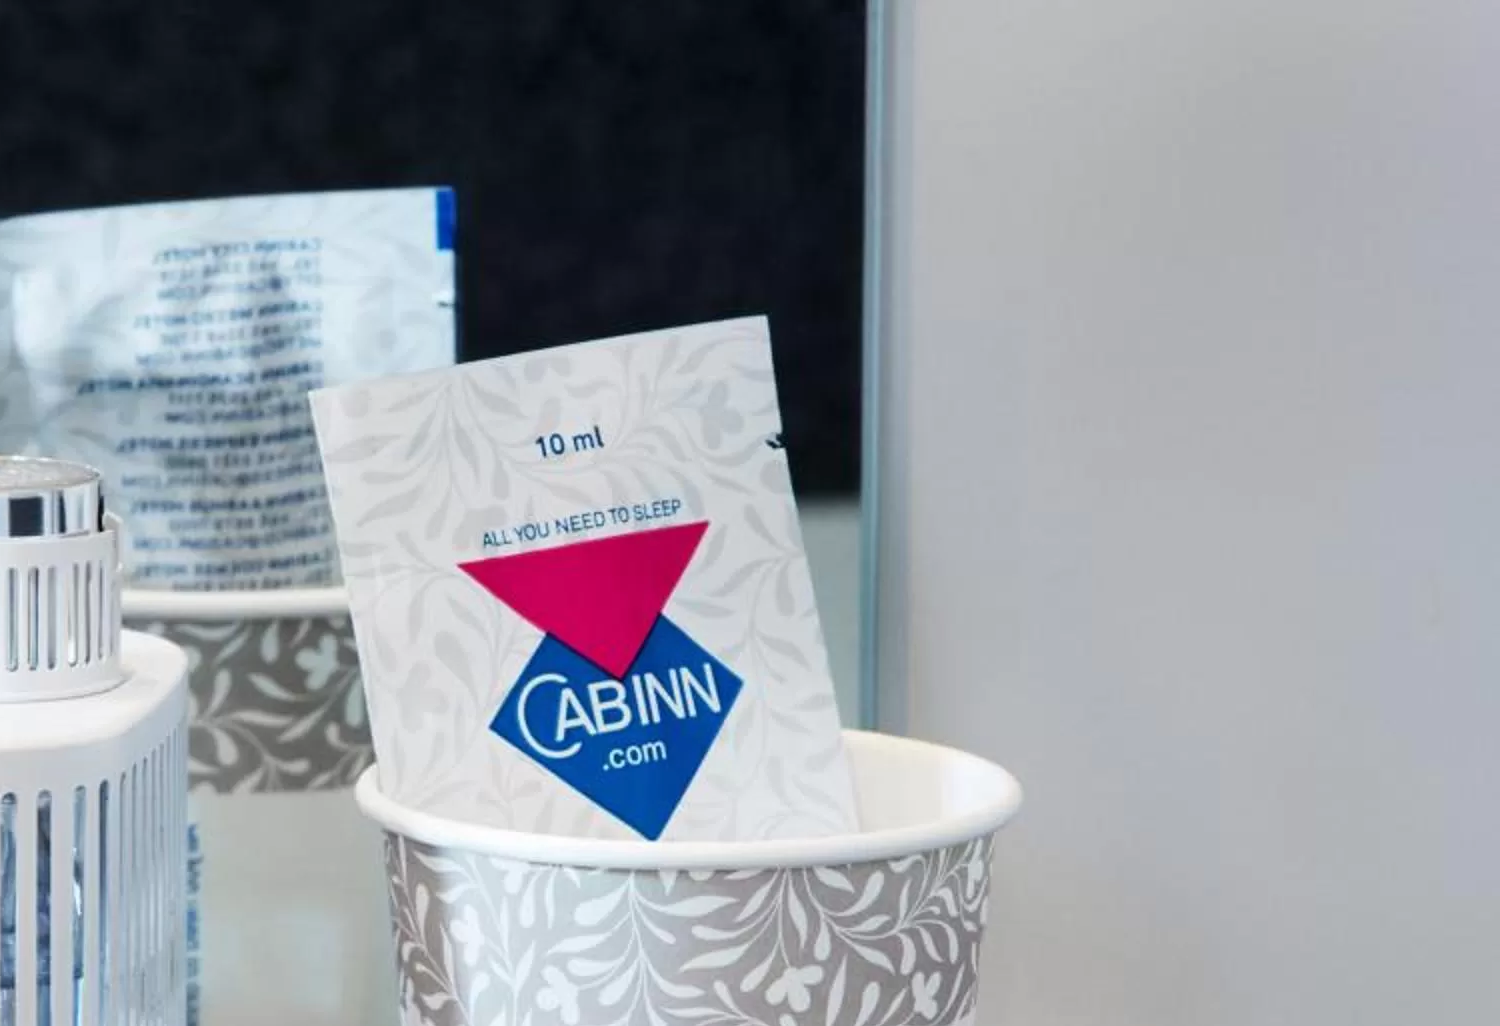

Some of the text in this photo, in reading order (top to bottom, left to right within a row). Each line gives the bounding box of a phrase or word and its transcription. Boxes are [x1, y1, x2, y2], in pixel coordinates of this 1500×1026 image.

[534, 426, 605, 459] 10 ml
[482, 498, 682, 549] ALL YOU NEED TO SLEEP
[516, 661, 722, 760] CABINN
[601, 737, 668, 772] .com
